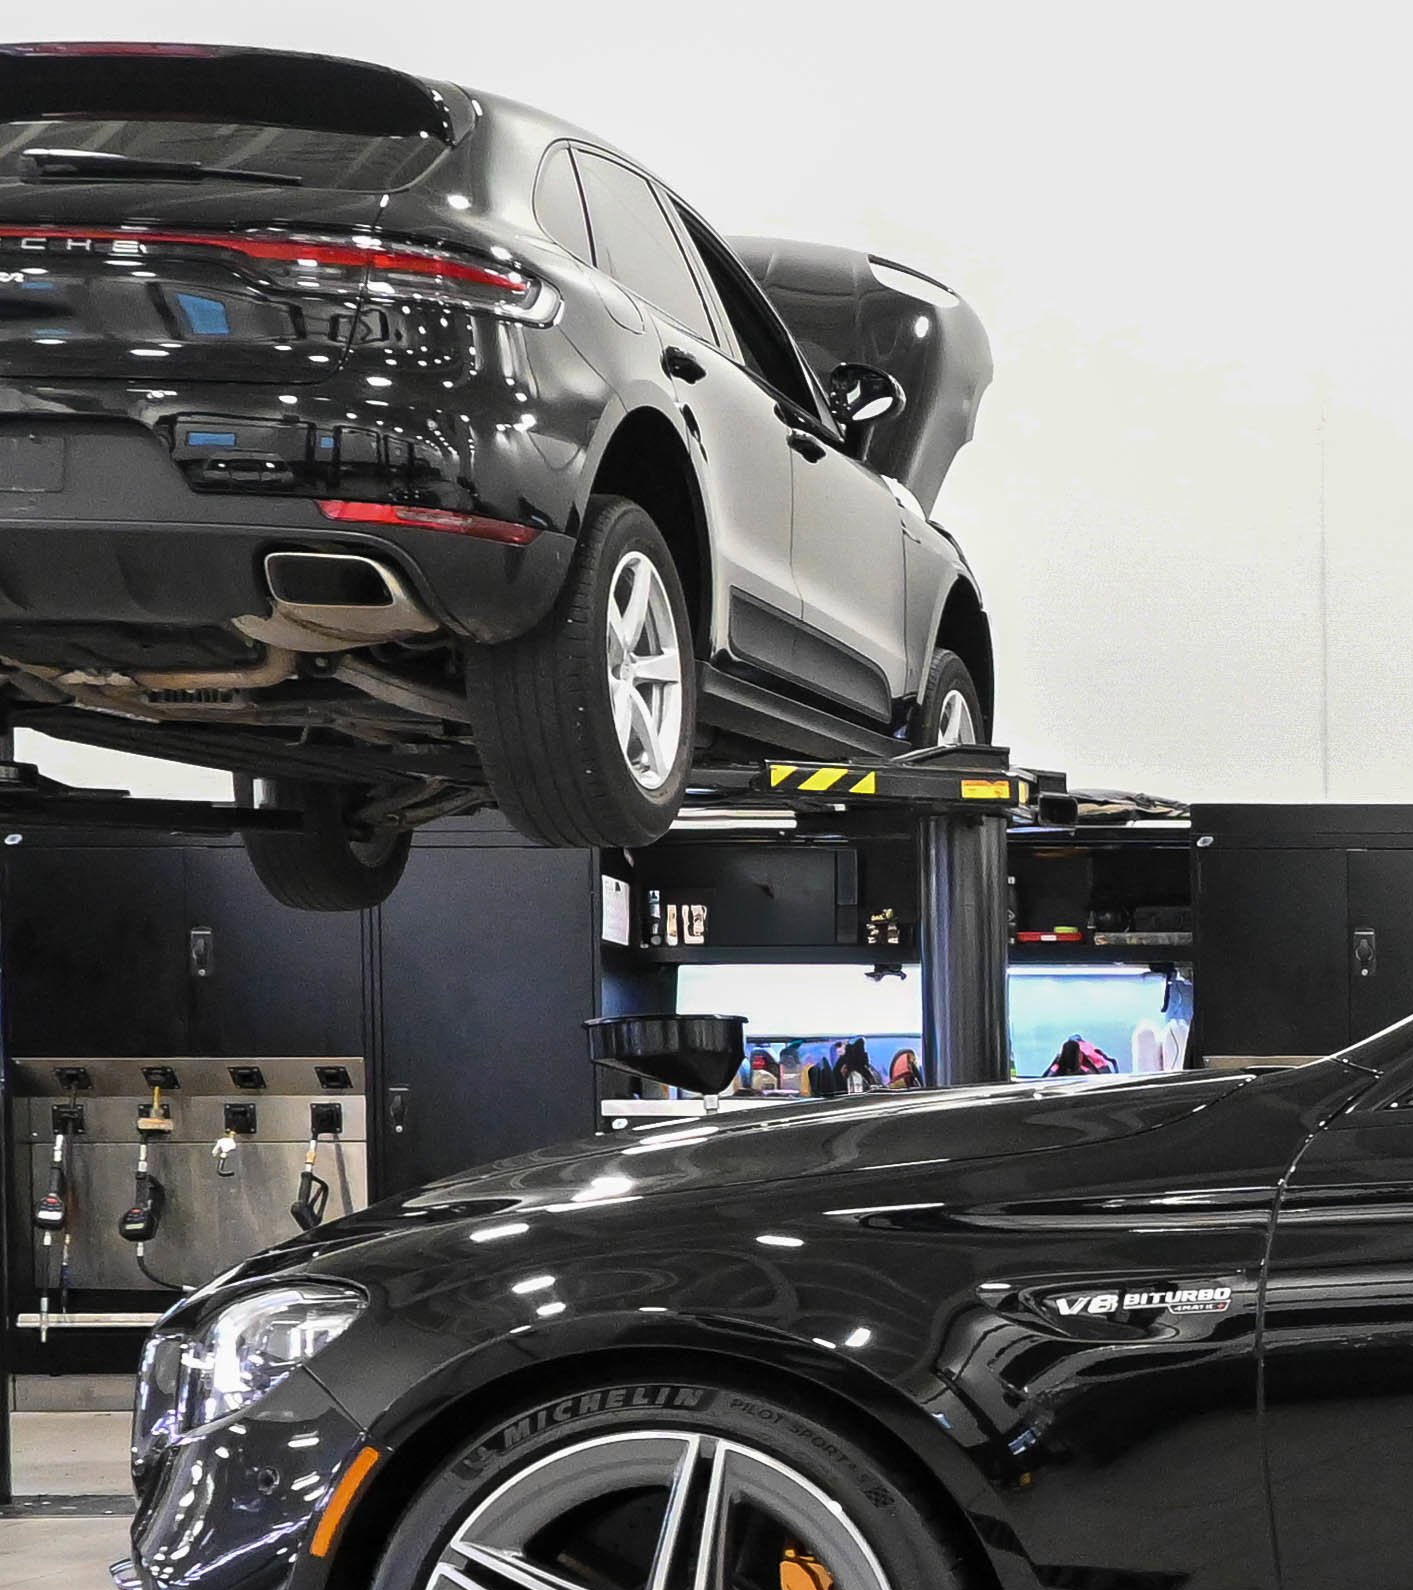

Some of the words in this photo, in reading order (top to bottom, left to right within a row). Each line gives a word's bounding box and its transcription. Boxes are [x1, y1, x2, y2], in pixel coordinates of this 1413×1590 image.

[0, 238, 139, 253] CHE
[1056, 1293, 1119, 1316] V8
[1124, 1287, 1232, 1305] BITURBO
[503, 1387, 702, 1448] MICHELIN
[730, 1398, 785, 1425] PILOT
[789, 1421, 850, 1464] SPORT
